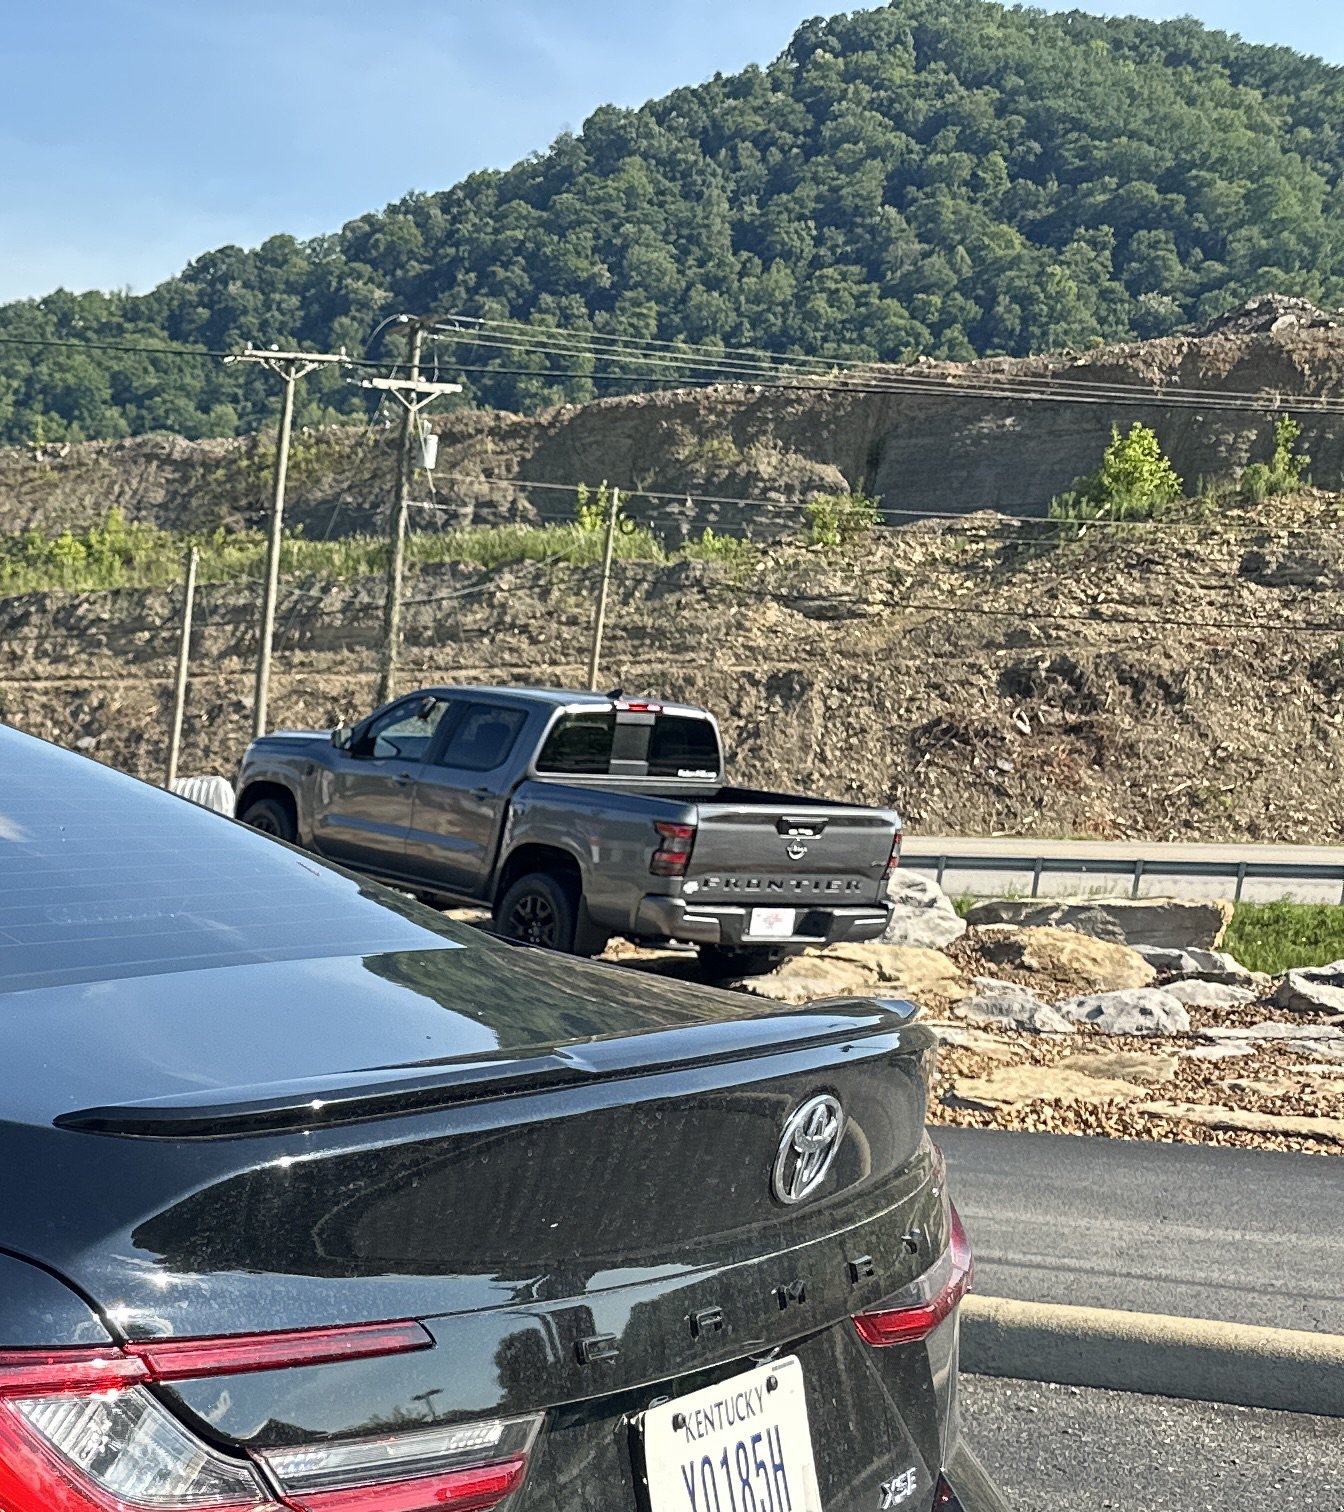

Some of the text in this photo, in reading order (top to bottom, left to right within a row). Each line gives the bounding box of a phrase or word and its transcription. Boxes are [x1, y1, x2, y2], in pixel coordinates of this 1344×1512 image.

[702, 877, 862, 894] FRONTIER
[576, 1228, 921, 1365] CAMRY
[685, 1384, 764, 1443] KENTUCKY
[879, 1467, 917, 1510] XSE
